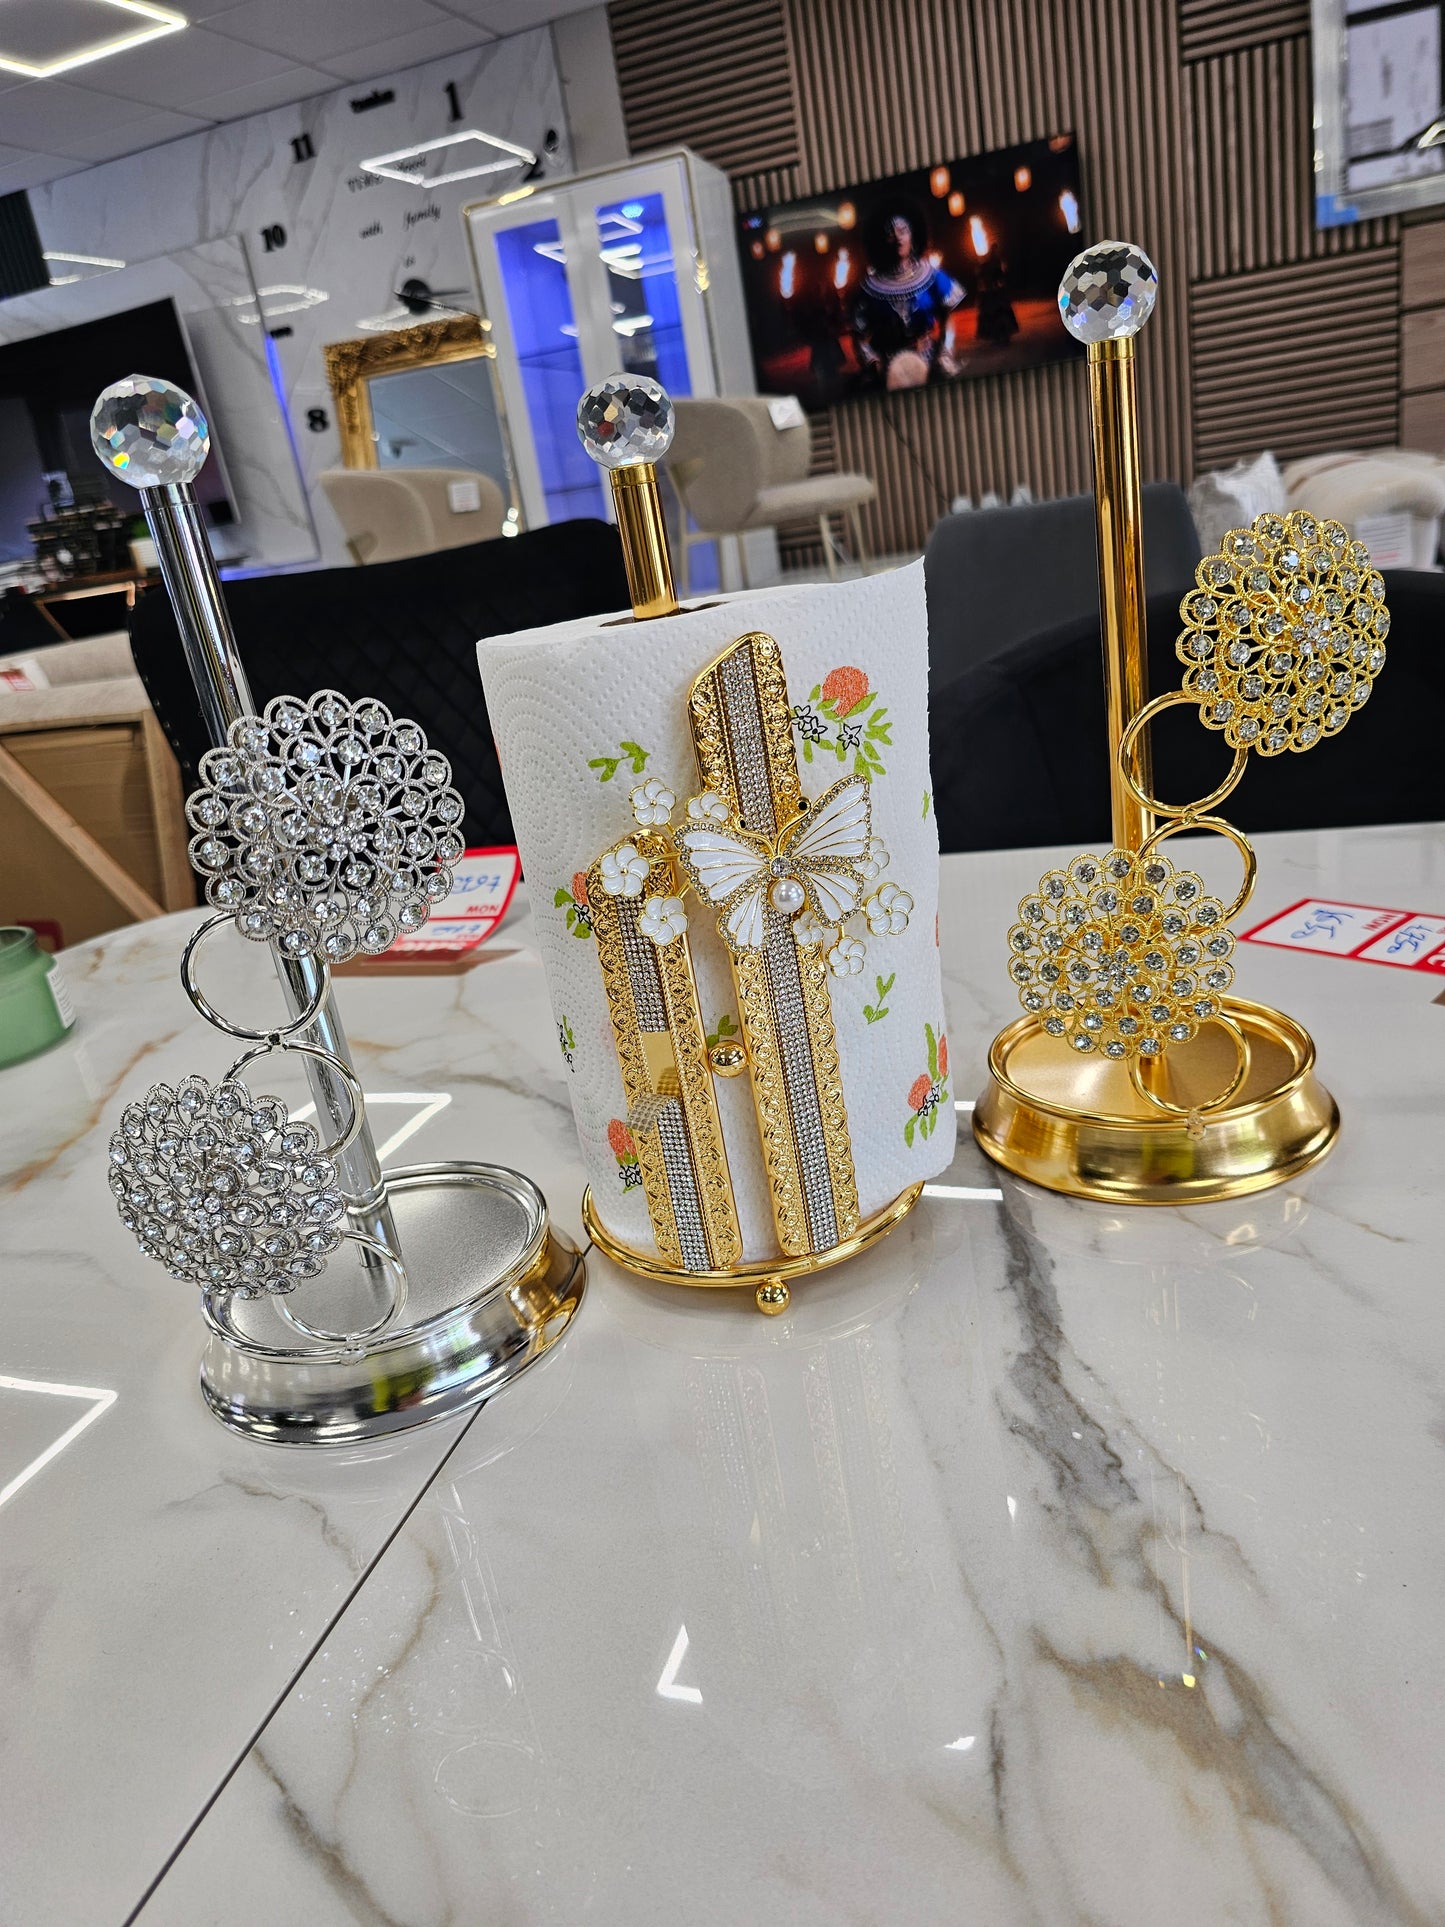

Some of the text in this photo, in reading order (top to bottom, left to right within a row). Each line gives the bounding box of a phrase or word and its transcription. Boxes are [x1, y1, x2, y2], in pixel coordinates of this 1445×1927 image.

[288, 133, 317, 164] 11
[261, 222, 287, 253] 10
[306, 407, 330, 433] 8
